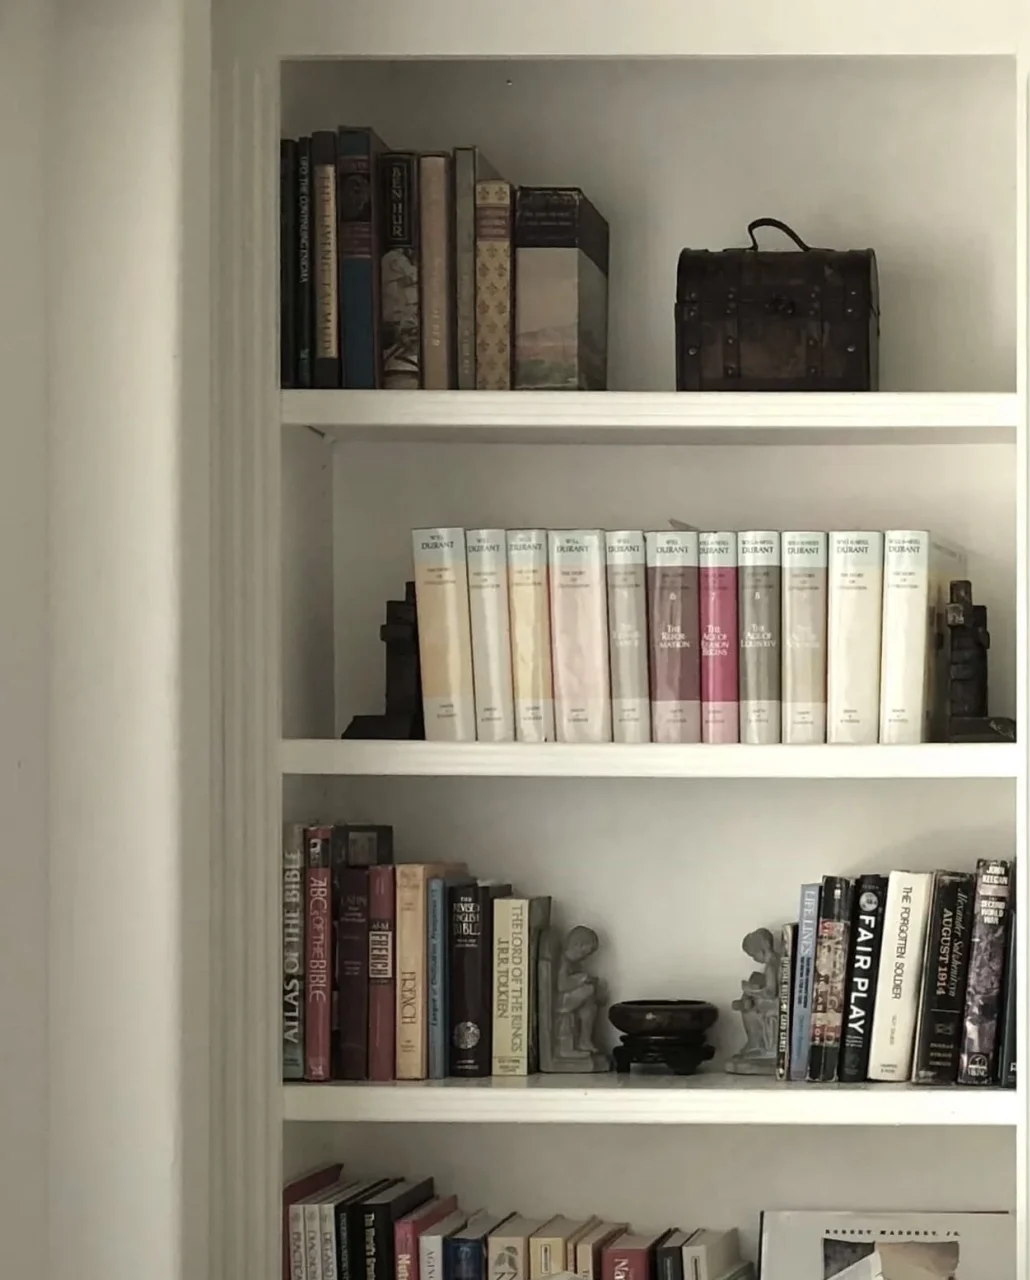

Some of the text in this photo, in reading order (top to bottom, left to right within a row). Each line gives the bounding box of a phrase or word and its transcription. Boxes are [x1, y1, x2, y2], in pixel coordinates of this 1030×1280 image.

[283, 909, 301, 944] THE
[801, 889, 816, 916] LIFE
[953, 887, 970, 938] Alexander
[283, 947, 301, 973] OF
[308, 876, 328, 1005] ABC's OF THE BIBLE
[371, 932, 390, 976] FRENCH
[799, 919, 815, 957] LINES
[891, 886, 913, 1000] THE FORGOTTEN SOLDIER
[936, 907, 954, 996] AUGUST 1914
[399, 970, 417, 1026] FRENCH
[496, 968, 510, 1020] TOLKIEN
[511, 905, 524, 1053] THE LORD OF THE RINGS
[847, 914, 877, 1035] FAIR PLAY
[283, 979, 301, 1044] ATLAS
[364, 1213, 375, 1227] The
